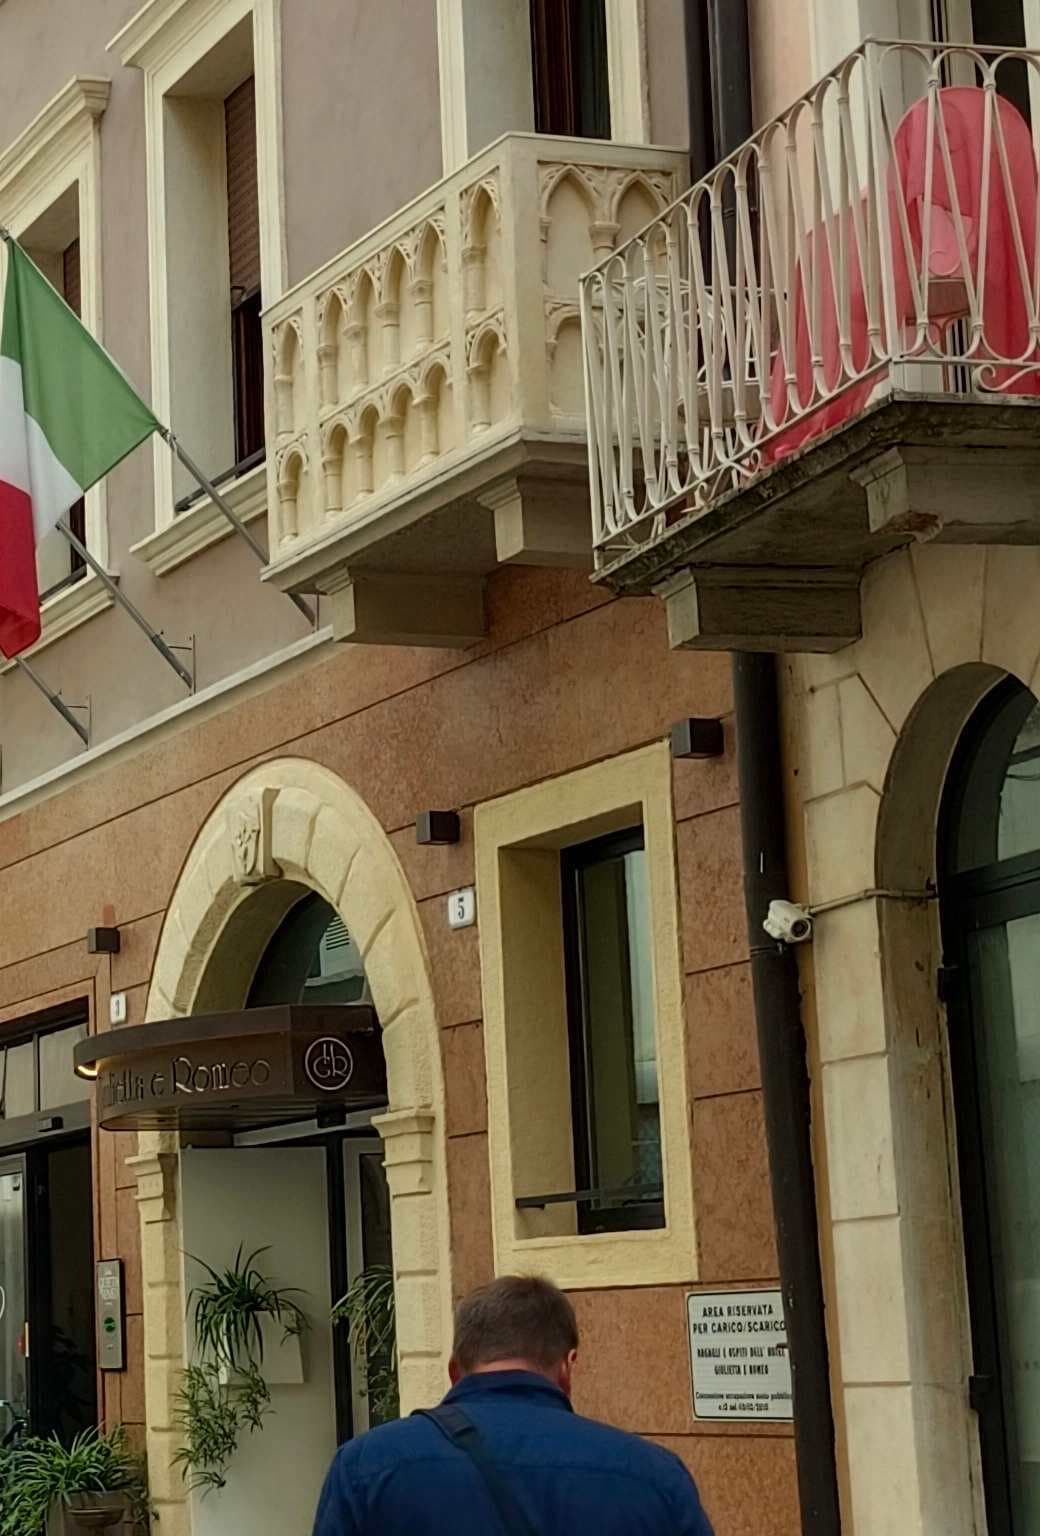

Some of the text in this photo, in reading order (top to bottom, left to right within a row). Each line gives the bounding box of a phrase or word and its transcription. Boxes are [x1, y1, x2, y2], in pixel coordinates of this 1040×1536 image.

[457, 896, 465, 920] 5
[171, 1056, 272, 1095] Romeo
[702, 1304, 773, 1318] AREA RISERVATA
[693, 1320, 786, 1334] PER CARICO/SCARICO
